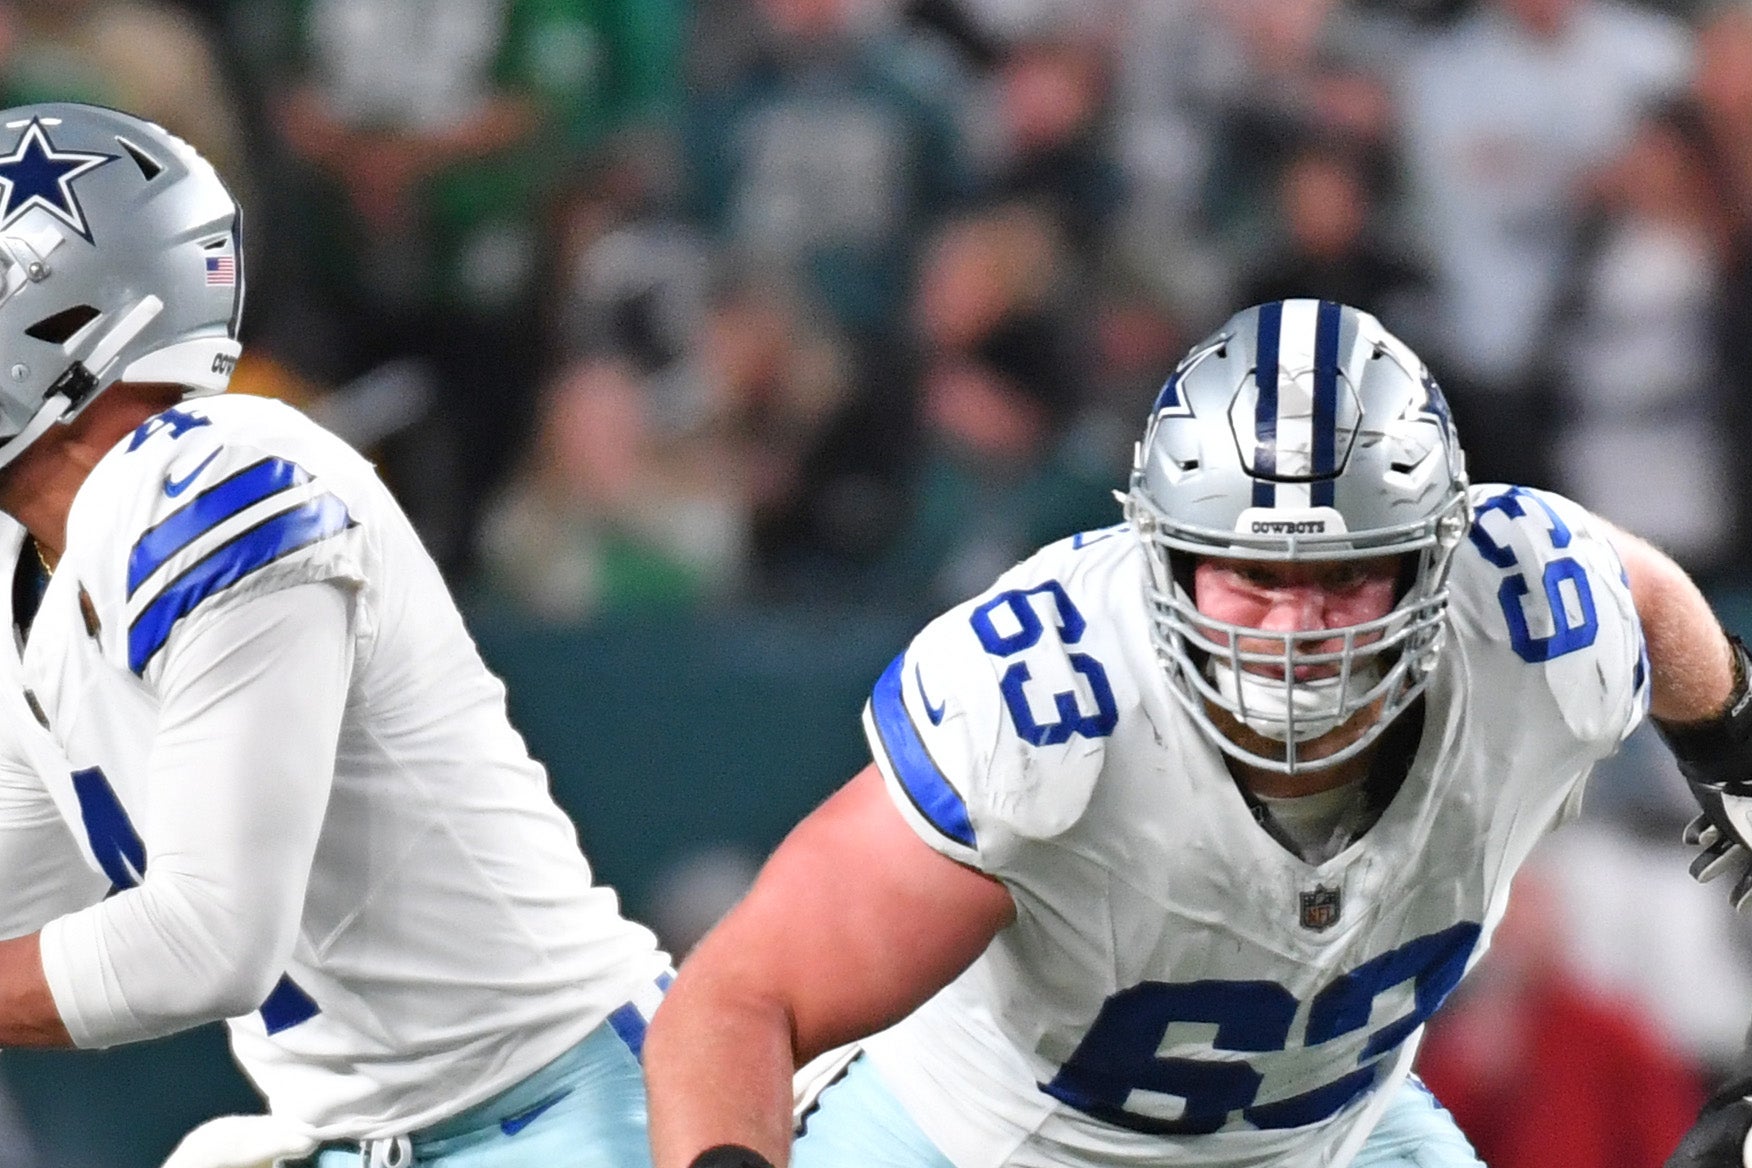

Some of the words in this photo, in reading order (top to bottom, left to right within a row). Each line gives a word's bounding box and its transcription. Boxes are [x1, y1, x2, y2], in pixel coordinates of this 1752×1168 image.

[1251, 520, 1325, 534] COWBOYS
[1468, 486, 1599, 664] 63
[968, 578, 1119, 747] 63
[1037, 921, 1483, 1134] 63
